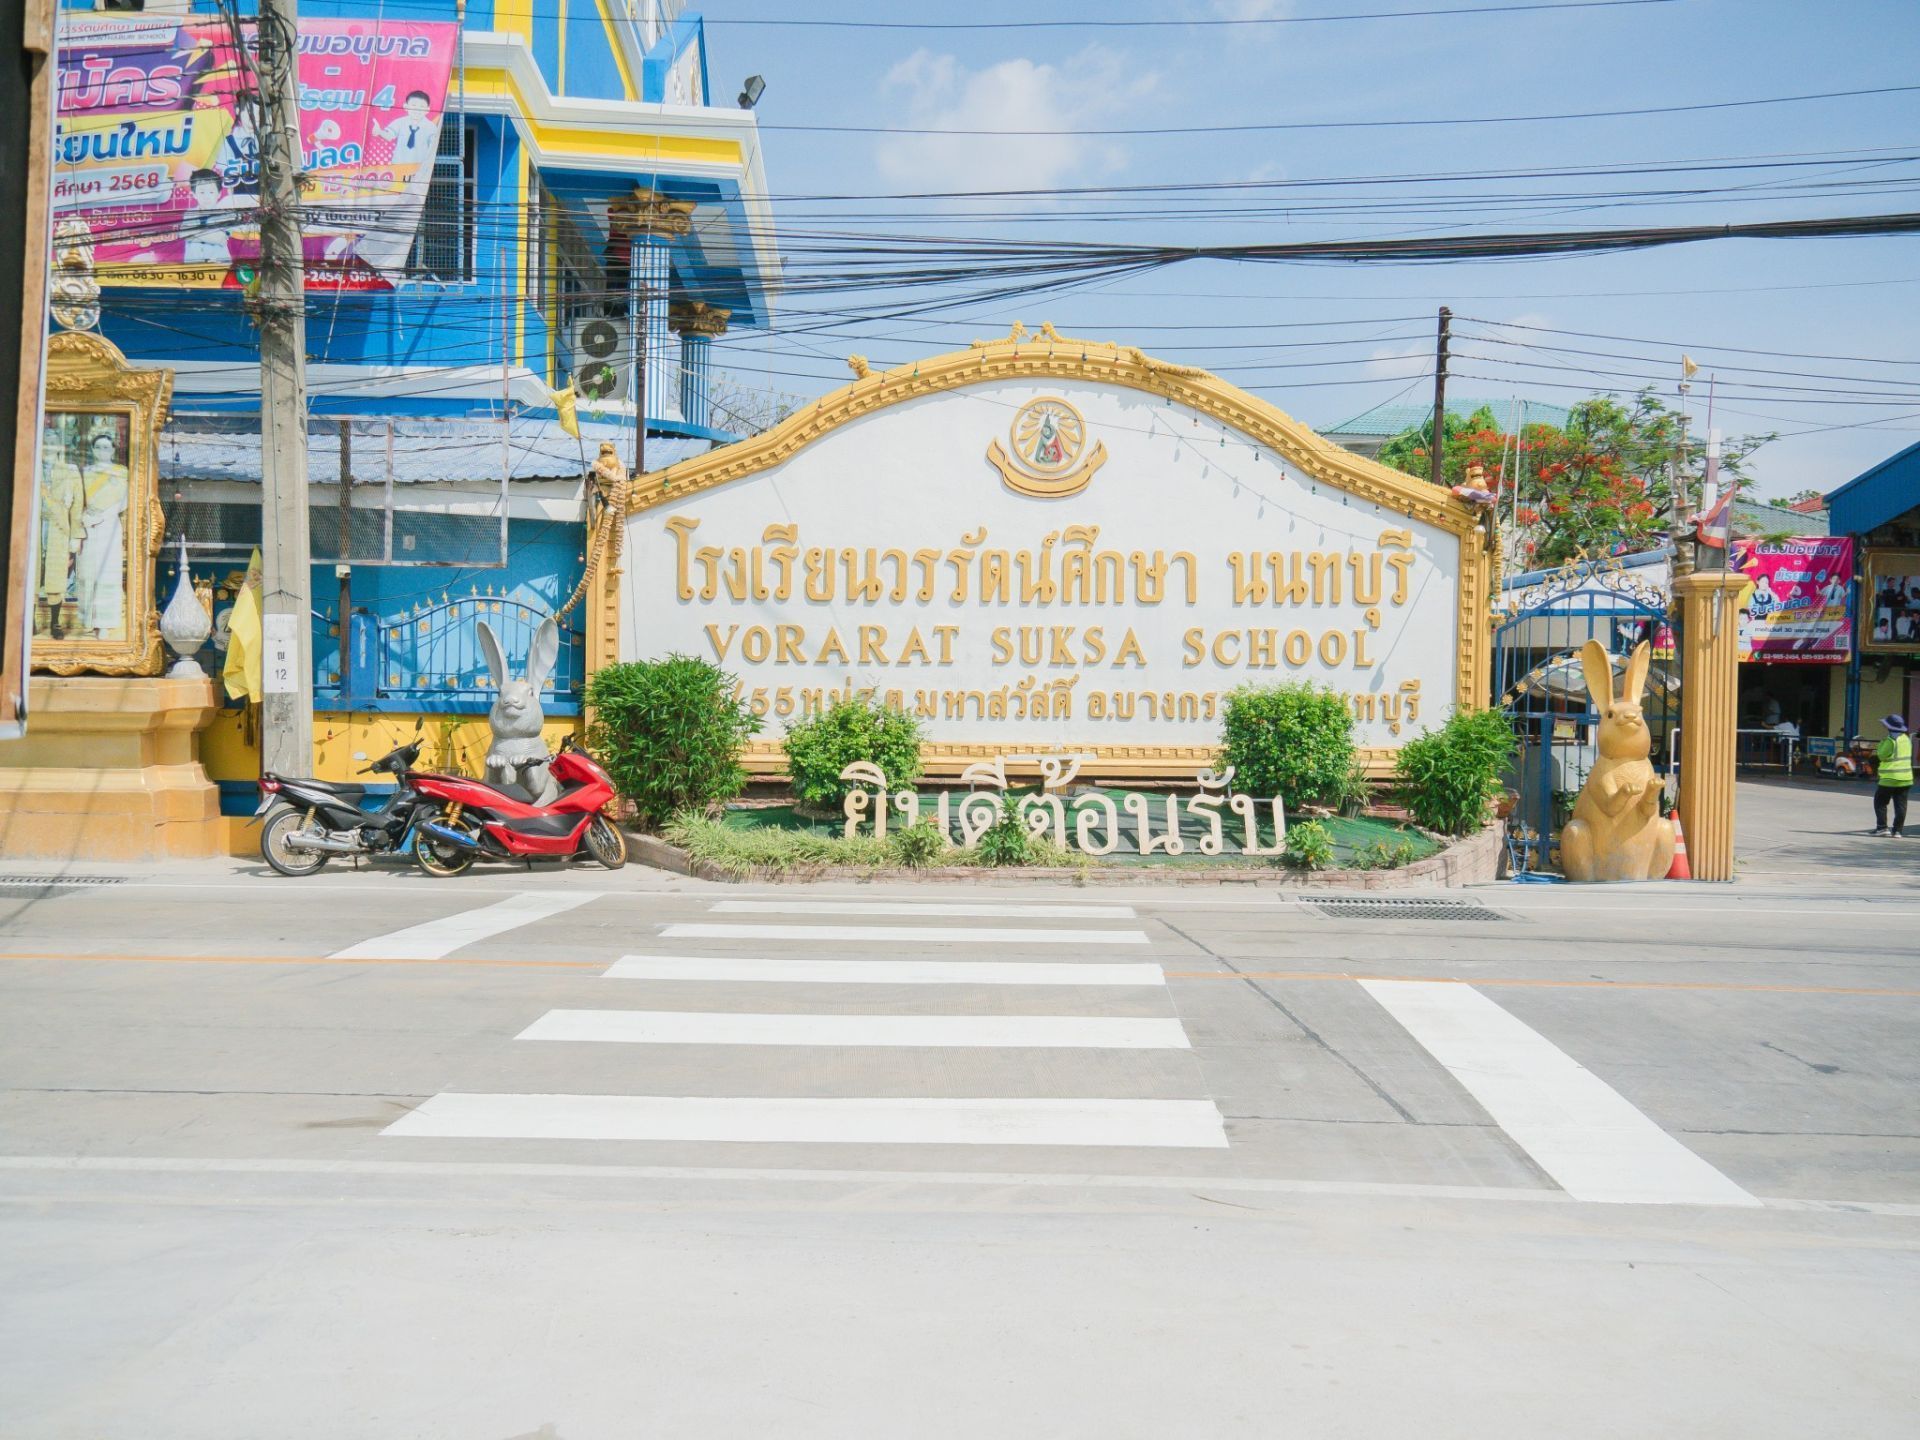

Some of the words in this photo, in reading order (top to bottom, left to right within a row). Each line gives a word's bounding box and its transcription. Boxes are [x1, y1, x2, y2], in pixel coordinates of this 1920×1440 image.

[372, 84, 396, 109] 4
[109, 171, 160, 191] 2568
[1228, 529, 1416, 628] นนทบุรี
[703, 624, 960, 664] VORARAT
[990, 624, 1148, 666] SUKSA
[1183, 627, 1376, 668] SCHOOL
[275, 669, 287, 681] 12
